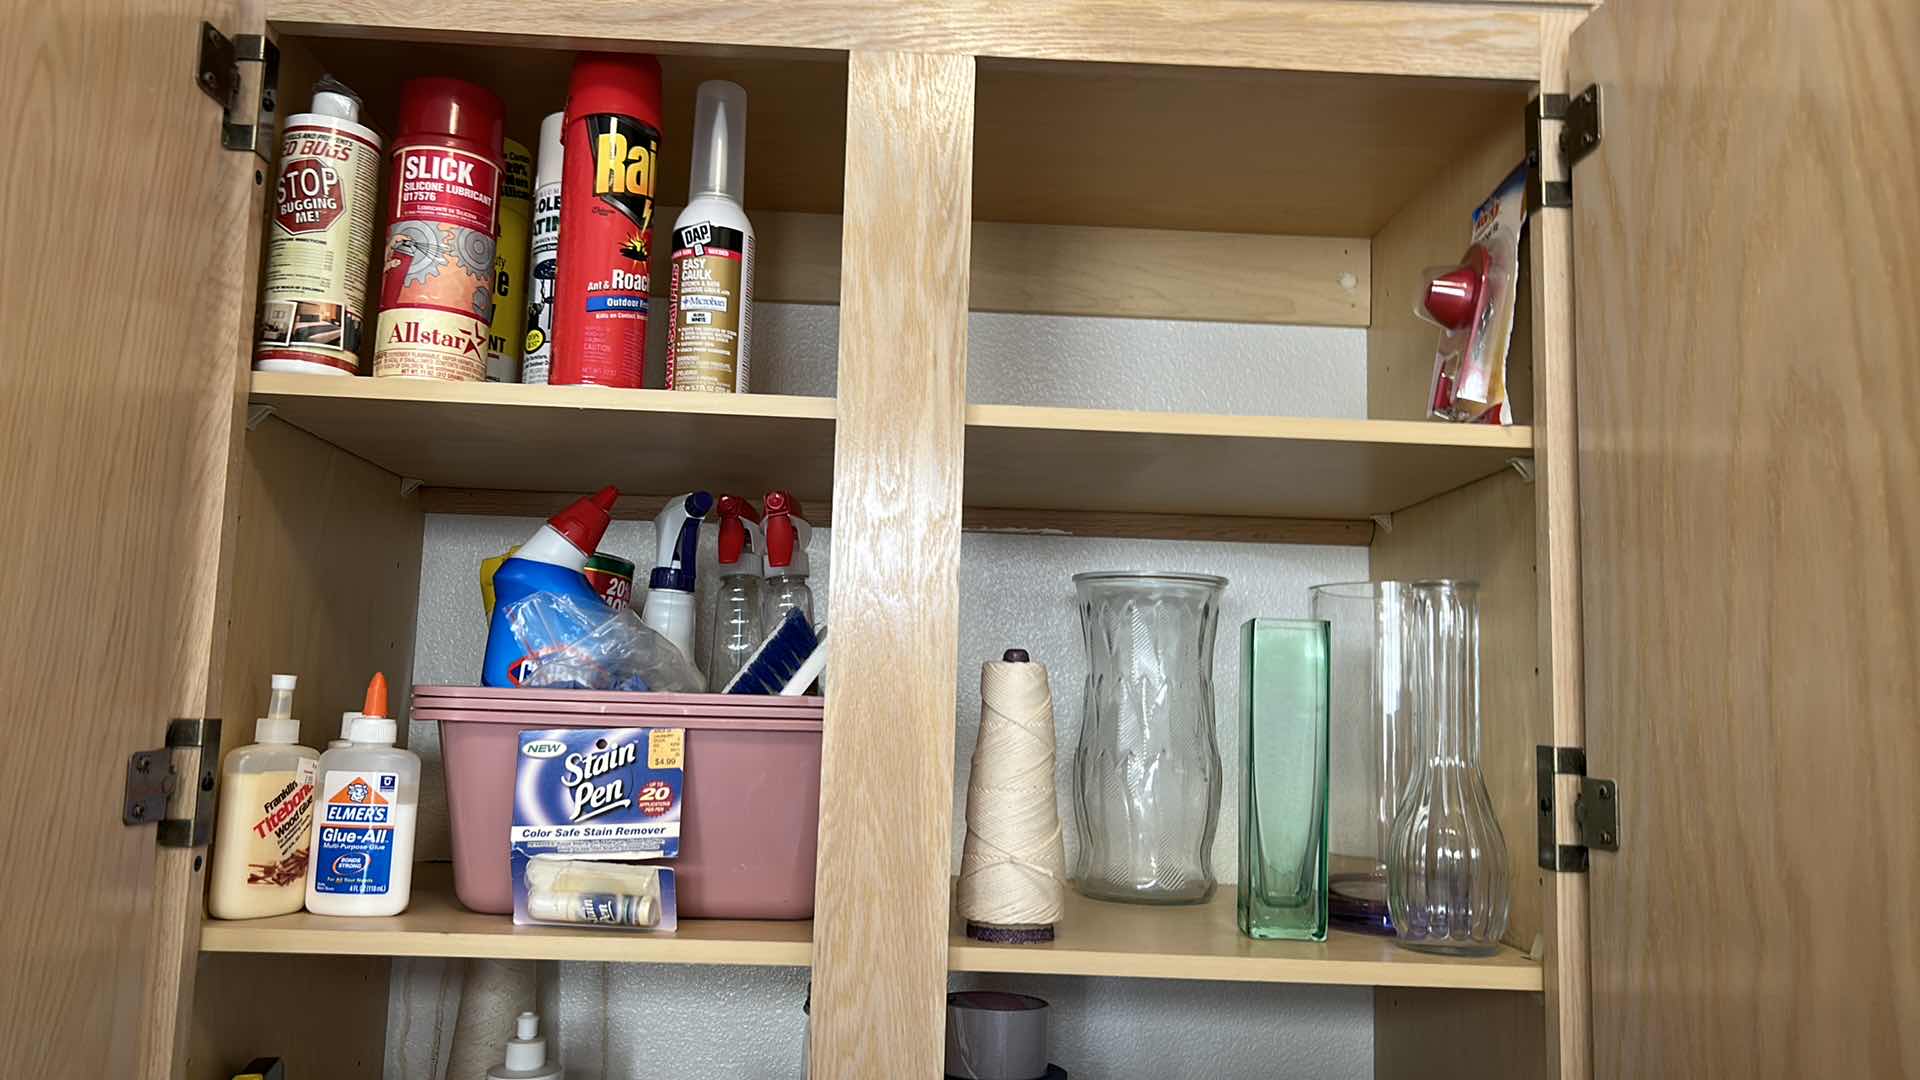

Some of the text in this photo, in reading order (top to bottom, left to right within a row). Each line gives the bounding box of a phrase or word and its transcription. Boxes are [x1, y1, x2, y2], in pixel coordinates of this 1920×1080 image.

[300, 141, 352, 161] BUGS
[405, 155, 474, 187] SLICK
[278, 167, 338, 204] STOP
[403, 181, 492, 208] SILICONE LUBRICANT
[403, 192, 437, 202] U17576
[280, 198, 337, 215] BUGGING
[295, 210, 320, 224] ME!
[682, 259, 706, 271] EASY
[681, 269, 713, 281] CAULK
[587, 281, 602, 292] Ant
[603, 280, 610, 289] &
[607, 298, 639, 307] Outdoor
[388, 321, 466, 350] Allstar
[526, 743, 561, 753] NEW
[561, 741, 635, 787] Stain
[264, 779, 298, 814] Franklin
[569, 778, 624, 820] Pen
[639, 786, 671, 801] 20
[328, 806, 385, 821] ELMER'S
[275, 810, 300, 839] Wood
[323, 828, 387, 843] Glue-All
[522, 826, 667, 839] Color Safe Stain Remover
